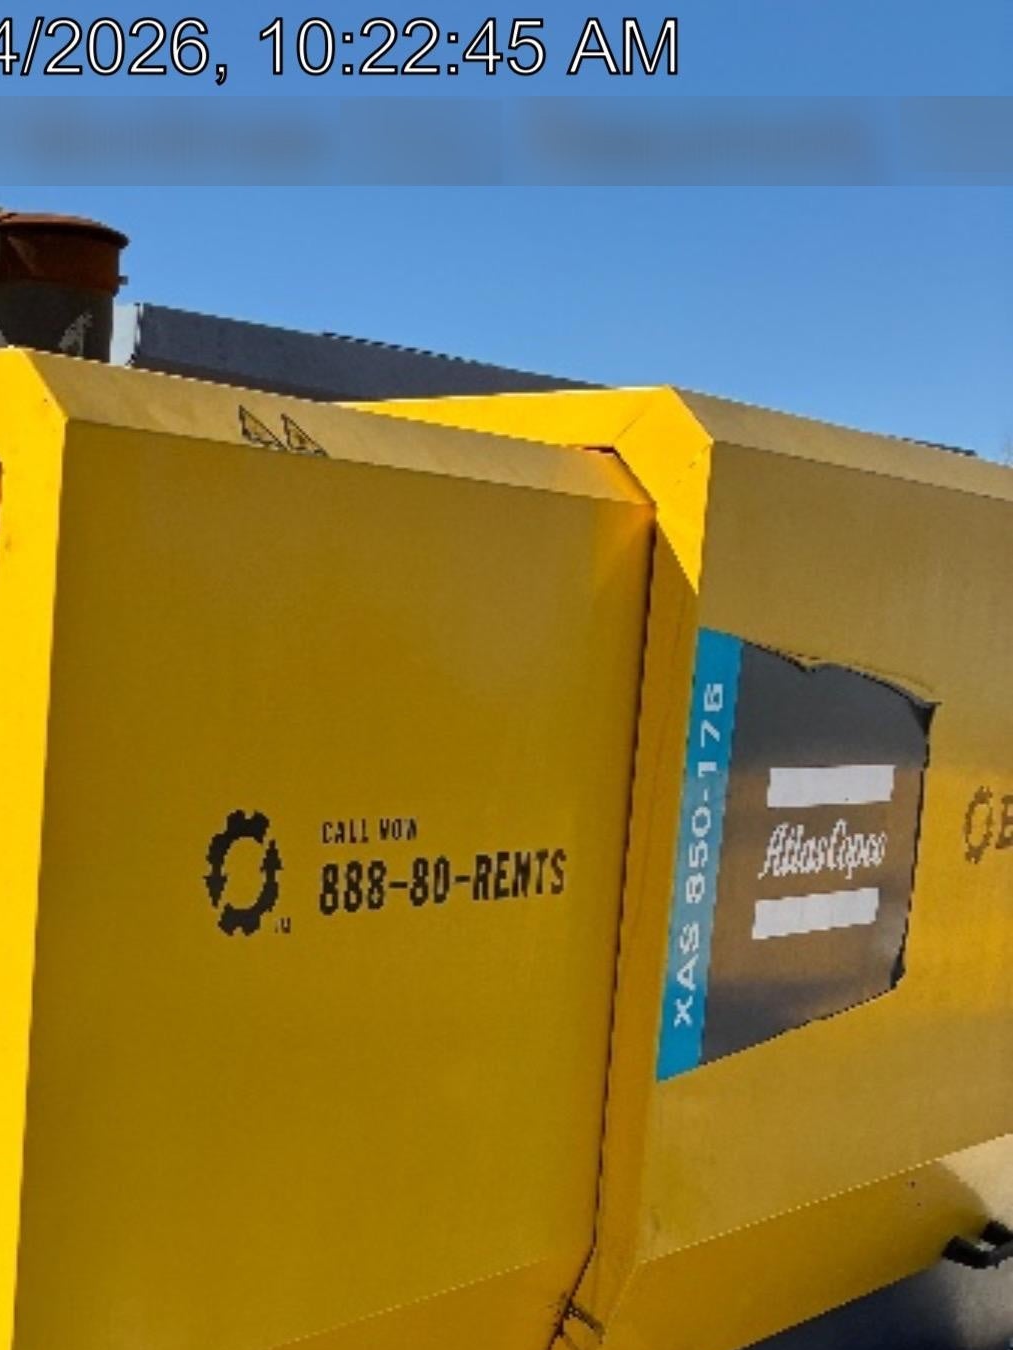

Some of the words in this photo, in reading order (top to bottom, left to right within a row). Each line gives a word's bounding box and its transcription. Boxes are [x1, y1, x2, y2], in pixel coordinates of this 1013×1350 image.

[322, 818, 369, 844] CALL
[685, 683, 723, 904] 850-176
[319, 848, 568, 915] 888-80-RENTS
[673, 921, 700, 1028] XAS
